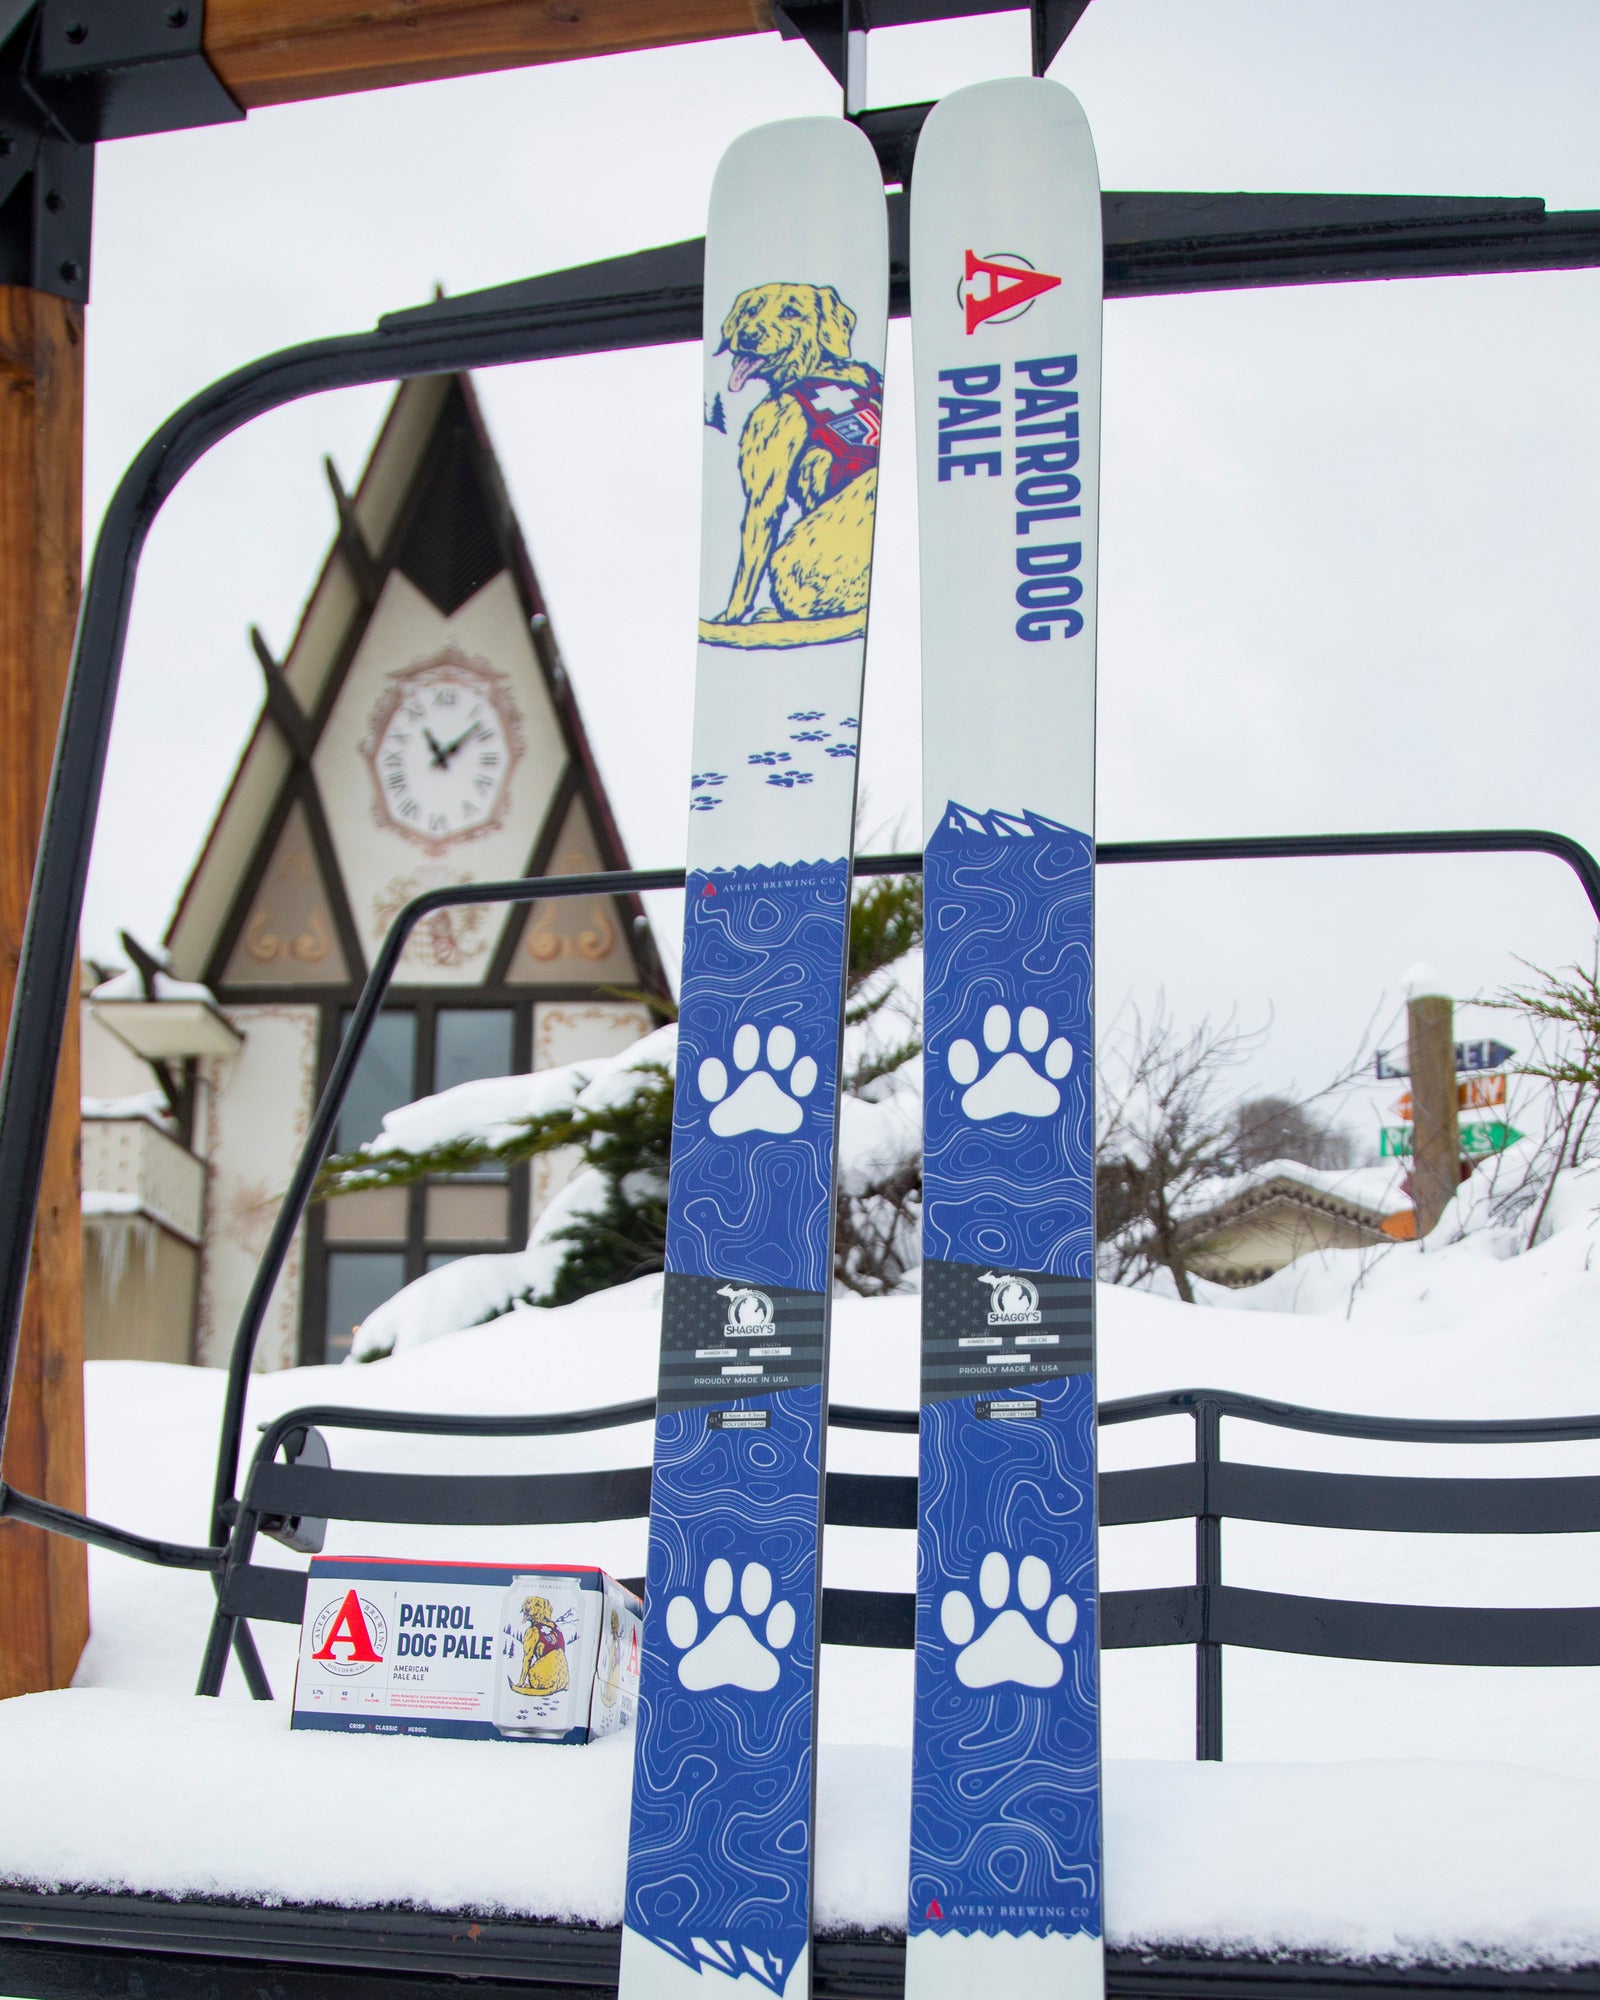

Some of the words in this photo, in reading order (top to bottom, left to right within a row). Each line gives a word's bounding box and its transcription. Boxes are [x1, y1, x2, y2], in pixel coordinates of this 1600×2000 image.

[965, 249, 1062, 335] A
[938, 364, 1002, 482] PALE
[1014, 354, 1082, 536] PATROL
[1015, 541, 1084, 642] DOG
[722, 883, 758, 893] AVERY
[763, 878, 816, 890] BREWING
[989, 1312, 1040, 1323] SHAGGY'S
[726, 1324, 774, 1335] SHAGGY'S
[694, 1377, 731, 1385] PROUDLY
[734, 1376, 758, 1384] MADE
[773, 1375, 789, 1383] USA
[959, 1366, 998, 1375] PROUDLY
[1001, 1365, 1026, 1373] MADE
[1041, 1364, 1059, 1372] USA
[311, 1588, 384, 1663] A
[314, 1609, 331, 1639] AVERY
[364, 1604, 385, 1650] BREWING
[399, 1603, 474, 1630] PATROL
[397, 1632, 437, 1658] DOG
[442, 1634, 493, 1660] PALE
[392, 1673, 410, 1681] PALE
[412, 1673, 425, 1681] ALE
[393, 1664, 429, 1673] AMERICAN
[951, 1905, 995, 1916] AVERY
[1000, 1905, 1065, 1917] BREWING
